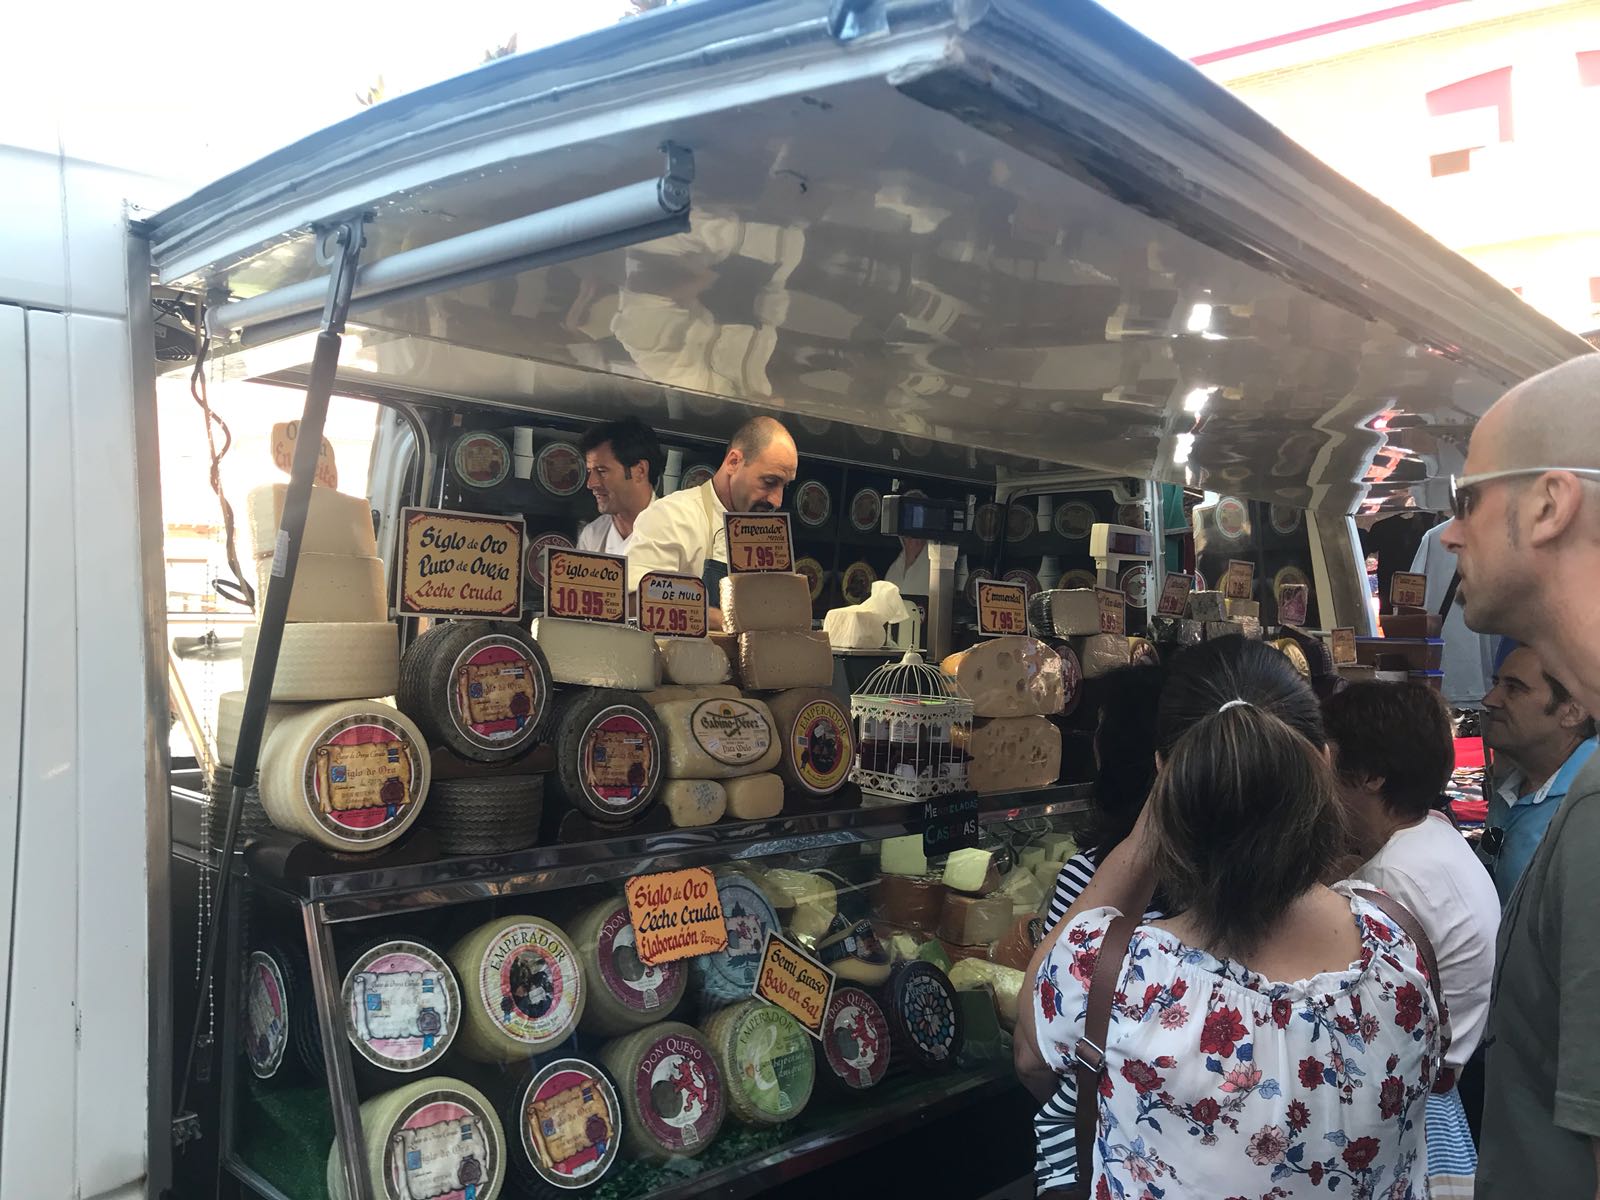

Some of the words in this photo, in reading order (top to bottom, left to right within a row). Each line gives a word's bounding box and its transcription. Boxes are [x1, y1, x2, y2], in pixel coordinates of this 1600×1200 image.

[420, 526, 466, 553] Siglo
[467, 538, 478, 549] de
[480, 535, 507, 554] Oro
[734, 519, 783, 537] Emperador
[418, 554, 454, 577] Puro
[456, 561, 468, 572] de
[470, 557, 510, 580] Oveja
[554, 558, 588, 579] Siglo
[590, 569, 600, 578] de
[600, 568, 619, 581] Oro
[744, 546, 774, 568] 7.95
[415, 580, 455, 598] Leche
[460, 583, 502, 600] Cruda
[650, 580, 673, 588] PATA
[662, 591, 675, 600] DE
[678, 591, 702, 601] MULO
[556, 586, 604, 616] 10.95
[646, 606, 688, 632] 12.95
[800, 705, 848, 736] EMPERADOR
[634, 884, 672, 911] Siglo
[673, 888, 682, 900] de
[683, 879, 708, 901] Oro
[603, 912, 627, 938] DON
[639, 909, 678, 933] Leche
[681, 902, 721, 925] Cruda
[490, 931, 567, 971] EMPERADOR
[641, 926, 699, 959] Elaboración
[771, 949, 798, 978] Semi
[796, 969, 826, 995] Graso
[764, 968, 787, 994] Bajo
[788, 987, 800, 1003] en
[801, 996, 820, 1019] Sal
[828, 998, 845, 1020] DON
[847, 992, 875, 1015] QUESO
[740, 1011, 793, 1044] EMPERADOR
[641, 1045, 664, 1074] DON
[666, 1038, 702, 1060] QUESO
